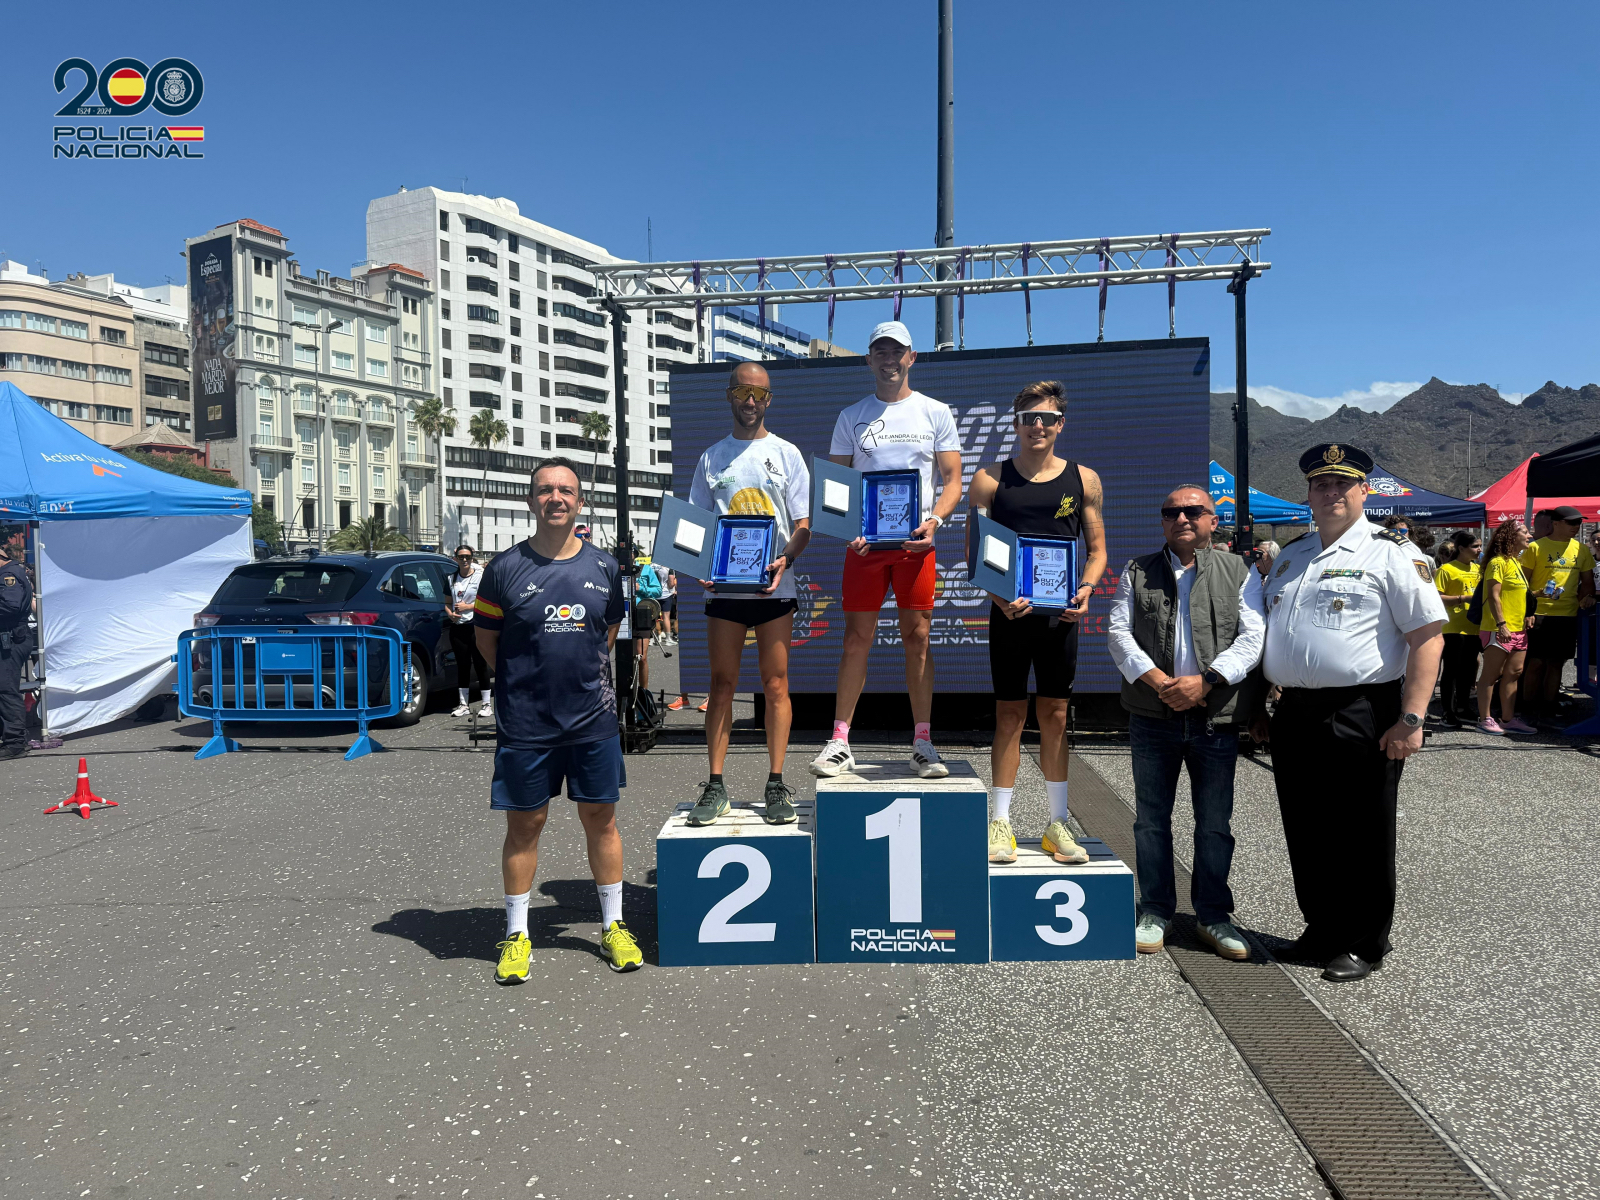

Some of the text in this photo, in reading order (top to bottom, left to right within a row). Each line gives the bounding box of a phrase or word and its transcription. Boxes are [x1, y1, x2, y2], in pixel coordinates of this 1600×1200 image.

[203, 358, 222, 372] NADA
[201, 368, 227, 384] MARIDA
[204, 381, 225, 395] MEJOR
[40, 452, 85, 462] Activa
[5, 498, 29, 508] tu vida
[740, 502, 763, 510] KEDA
[1363, 506, 1393, 517] mupol
[865, 797, 922, 923] 1
[697, 843, 777, 943] 2
[1034, 879, 1089, 946] 3
[850, 941, 956, 952] NACIONAL
